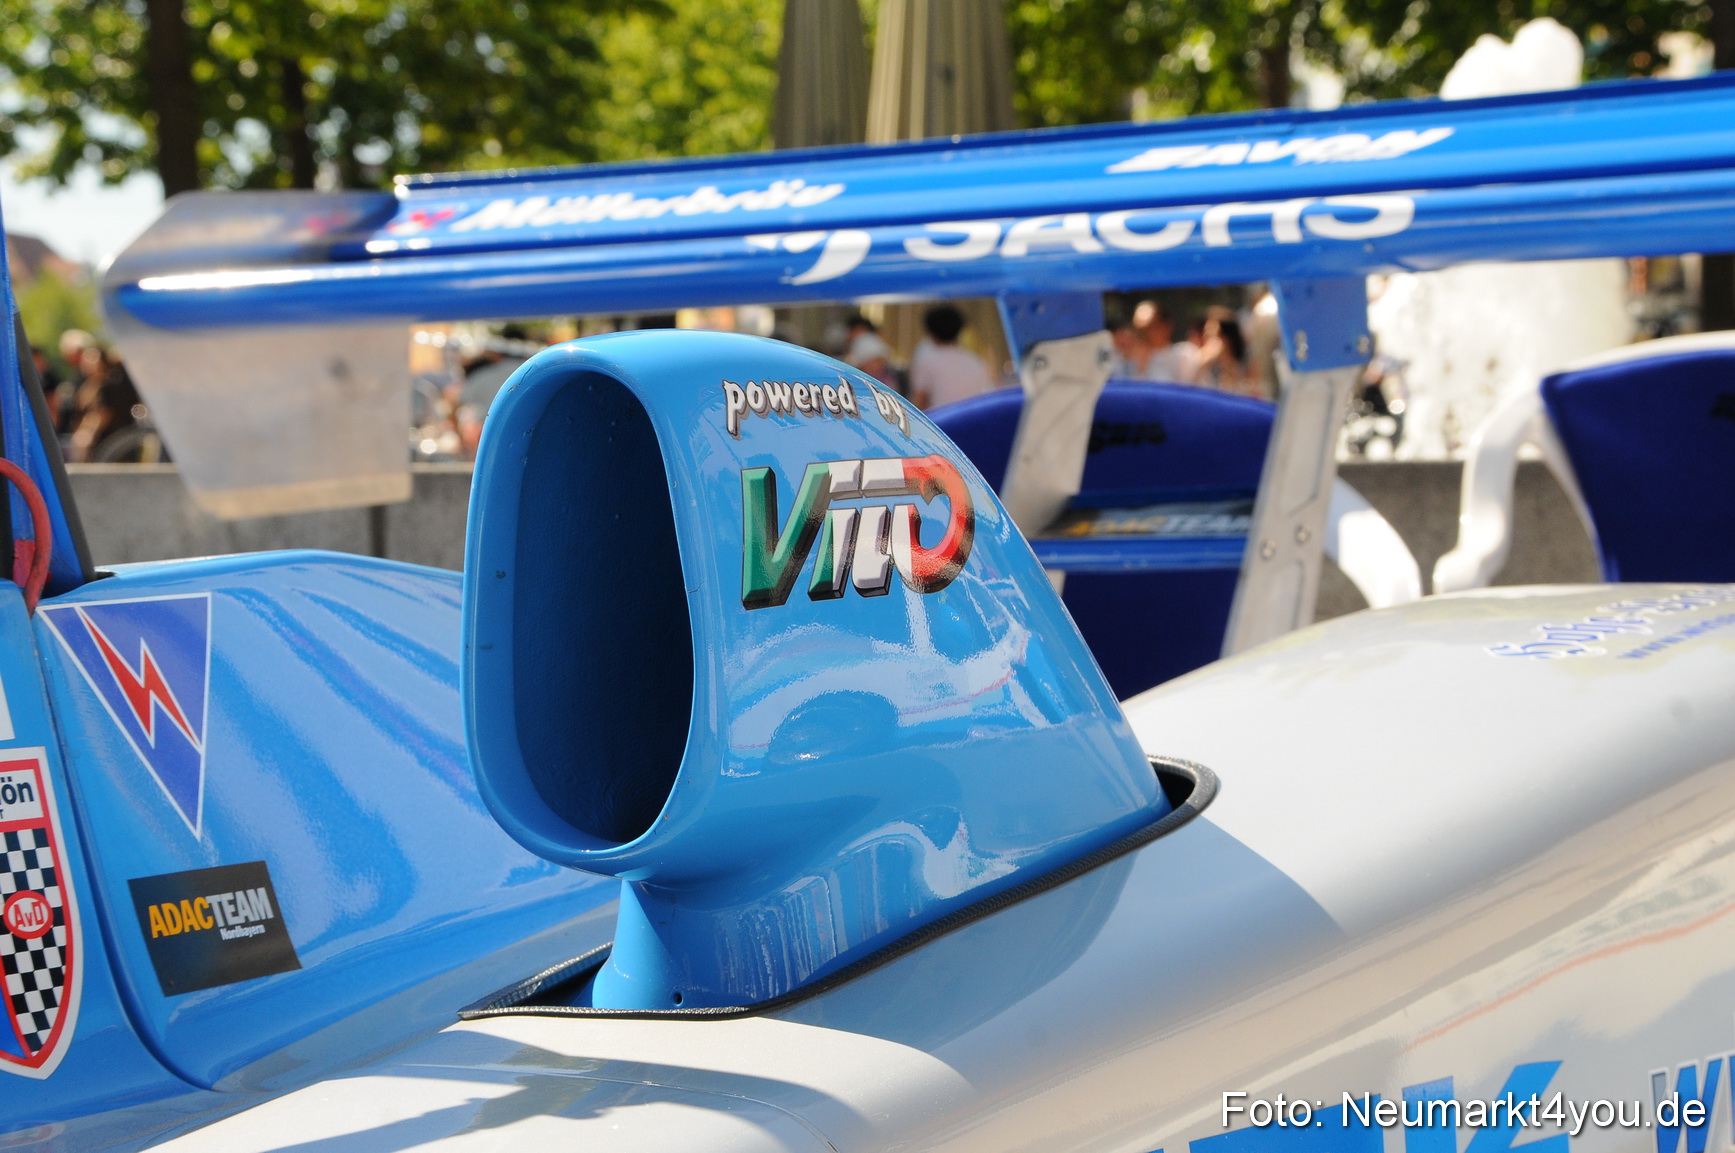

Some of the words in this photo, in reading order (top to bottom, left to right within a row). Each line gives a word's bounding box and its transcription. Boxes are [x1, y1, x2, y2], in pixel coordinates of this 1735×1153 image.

[722, 376, 861, 440] powered
[864, 381, 911, 438] by
[0, 776, 34, 805] ön
[13, 901, 45, 929] AvD
[219, 924, 266, 941] Nordbayern
